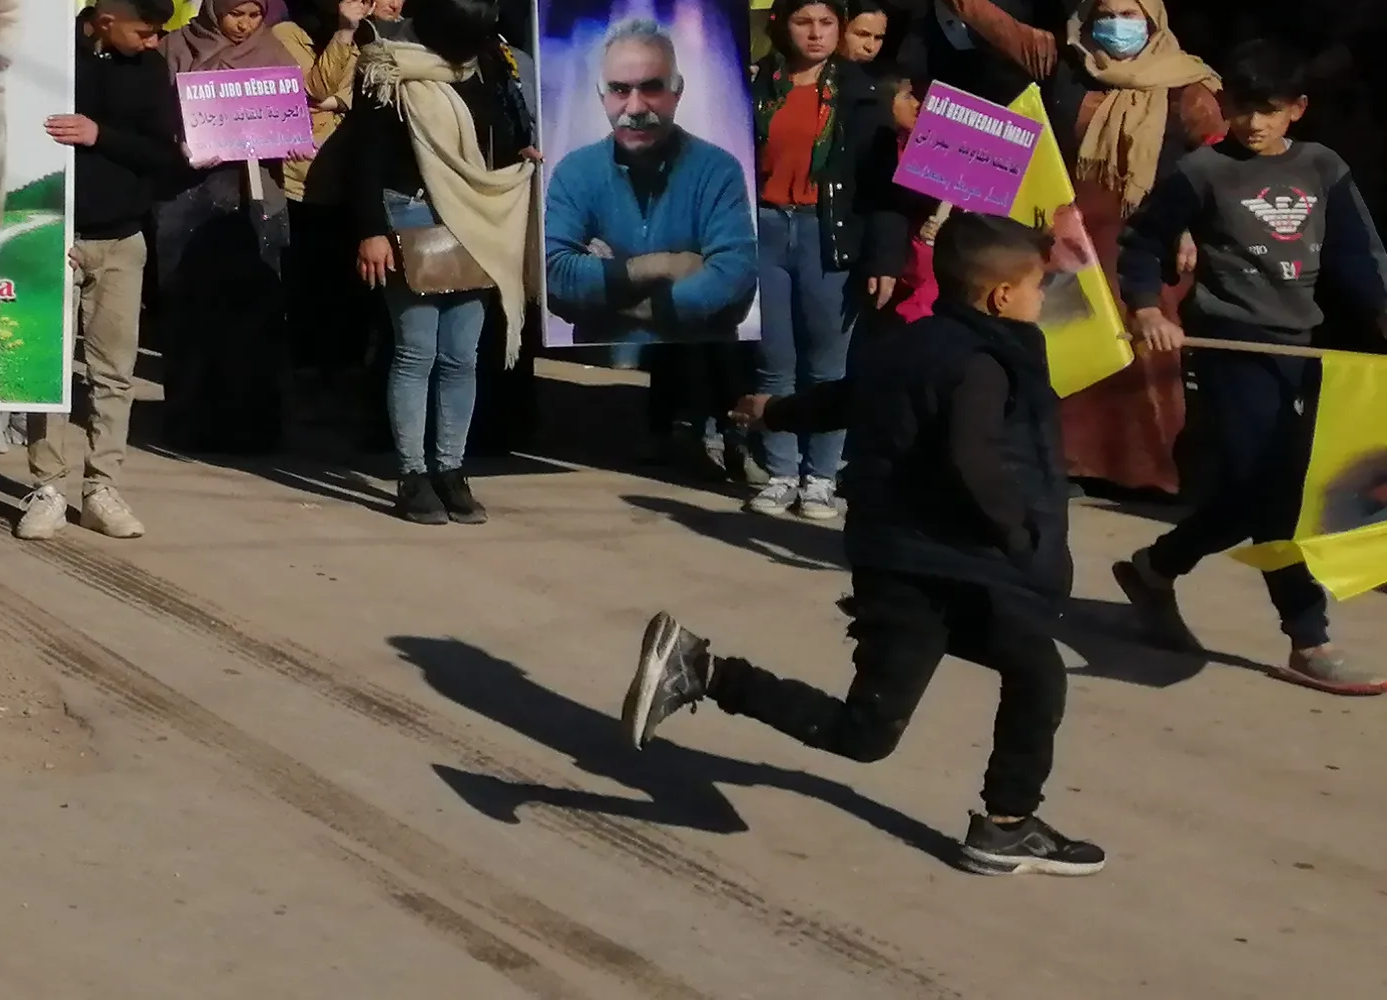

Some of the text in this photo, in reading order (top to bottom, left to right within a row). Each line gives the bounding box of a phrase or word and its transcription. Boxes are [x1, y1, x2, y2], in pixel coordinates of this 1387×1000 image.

[185, 77, 299, 101] AZADÎ JIBO RÊBER APO
